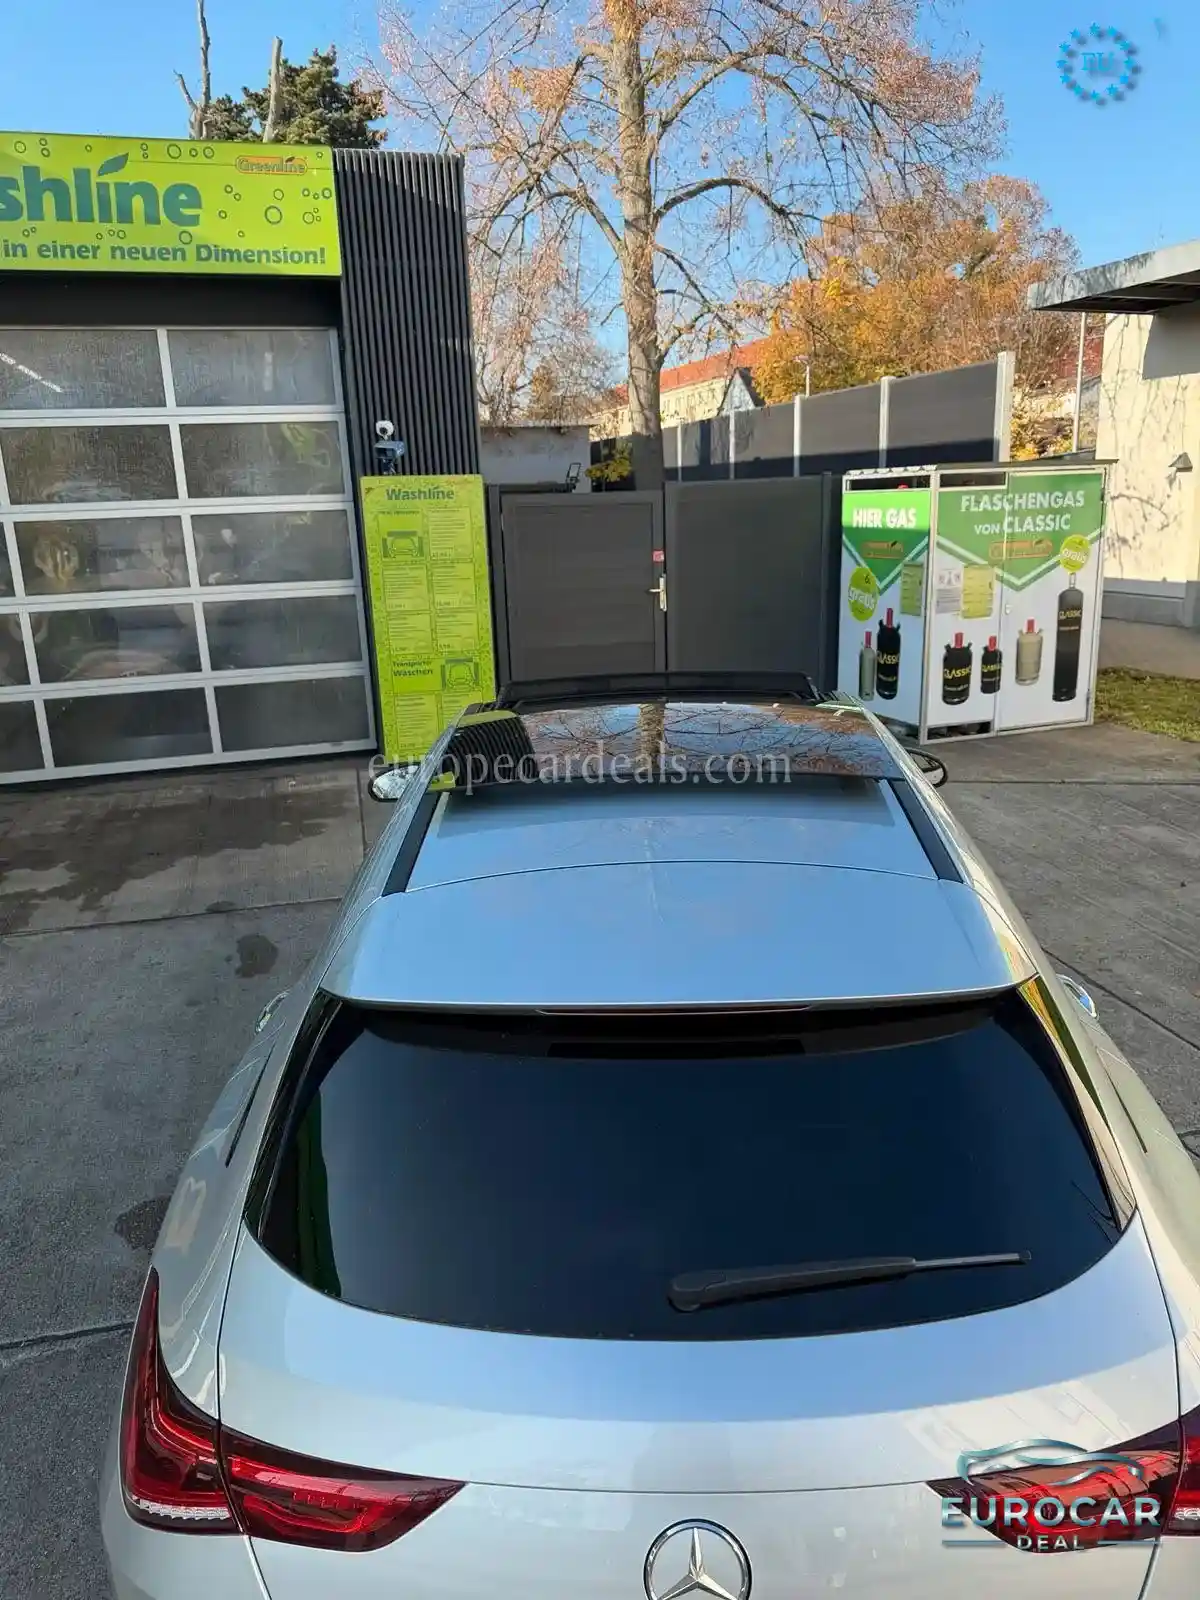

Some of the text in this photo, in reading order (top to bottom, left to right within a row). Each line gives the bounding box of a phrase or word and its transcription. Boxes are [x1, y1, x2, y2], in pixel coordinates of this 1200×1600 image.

[3, 240, 326, 265] in einer neuen Dimension!
[386, 486, 455, 501] Washline
[961, 490, 1084, 512] FLASCHENGAS
[853, 508, 917, 528] HIER GAS
[975, 514, 1071, 535] VON CLASSIC
